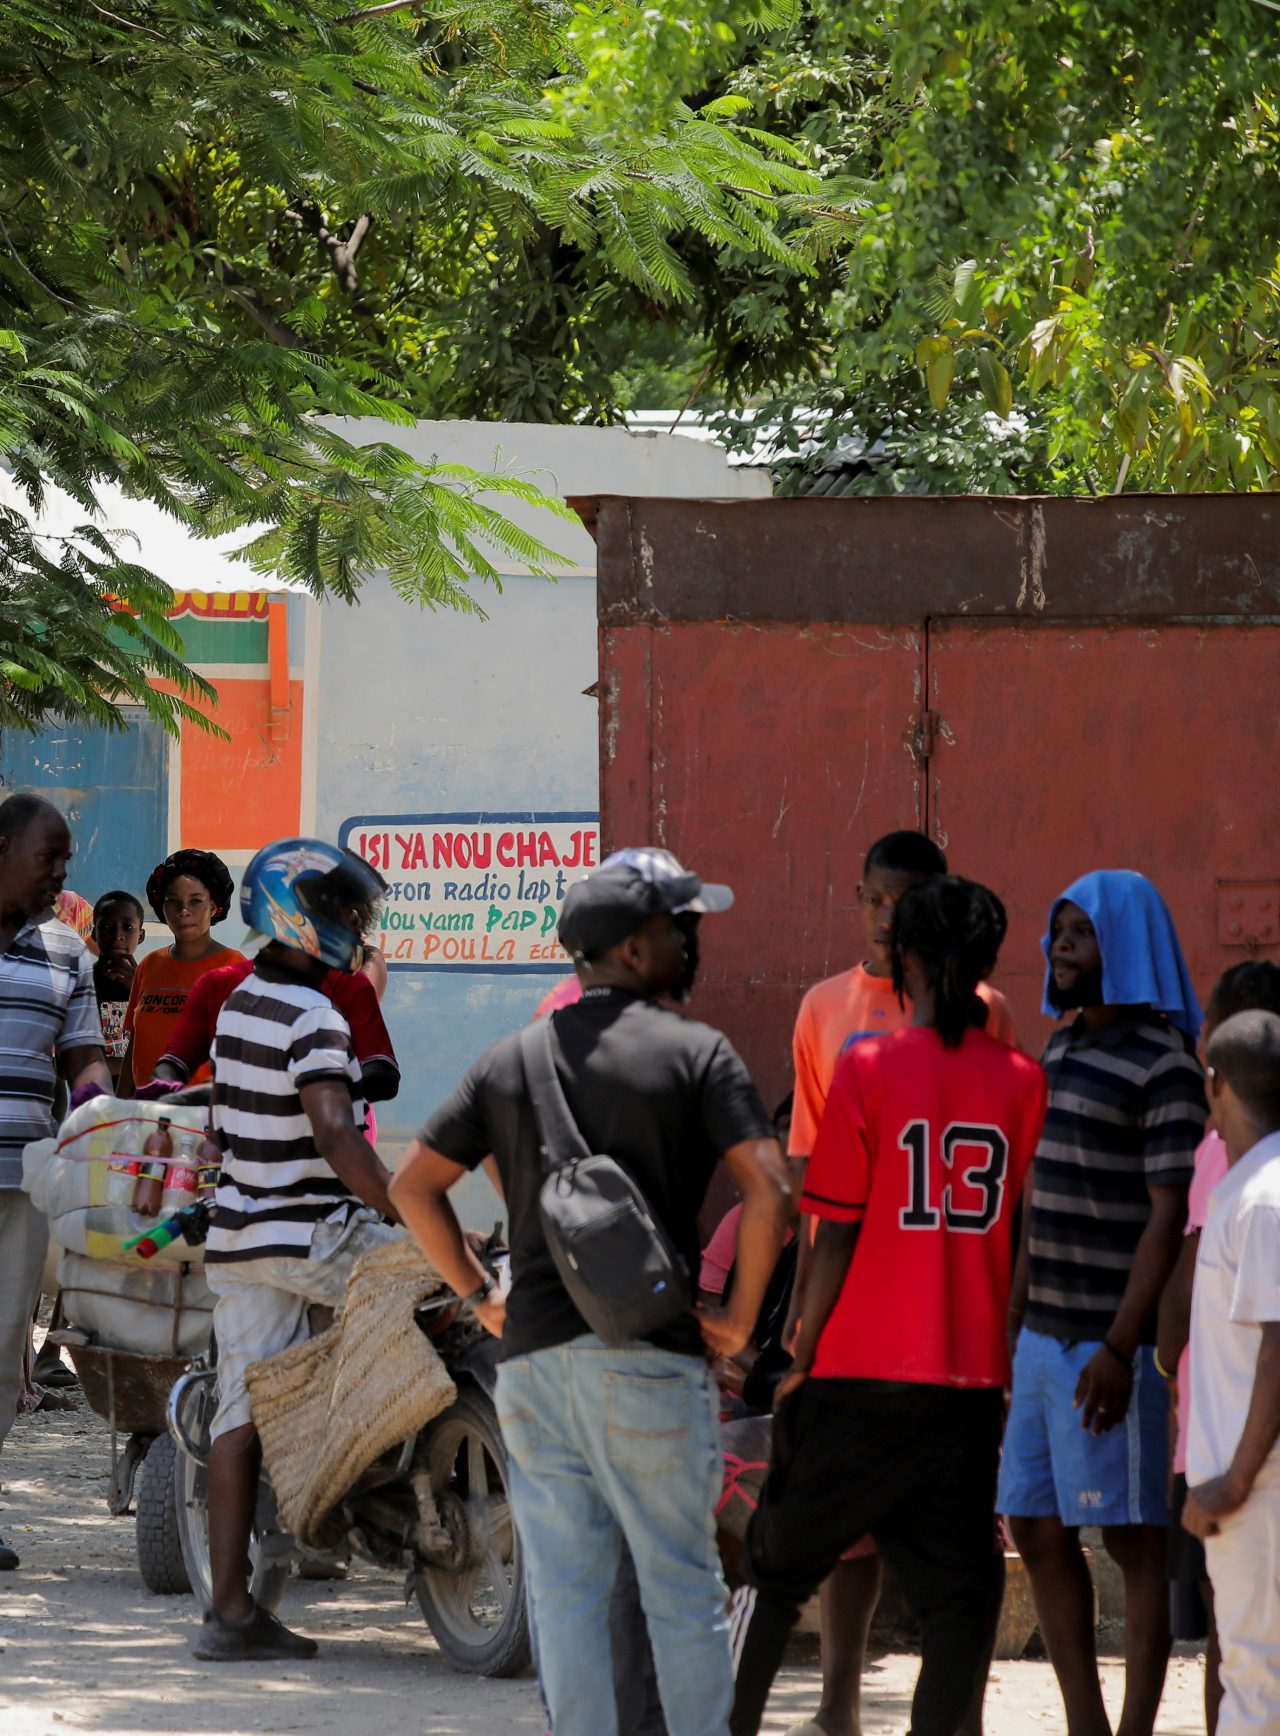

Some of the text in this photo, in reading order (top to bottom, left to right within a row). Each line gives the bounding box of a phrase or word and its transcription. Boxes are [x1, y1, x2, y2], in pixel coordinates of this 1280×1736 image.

[359, 830, 598, 870] ISI YA NOU CHAJE
[443, 872, 512, 902] Radio
[898, 1118, 1009, 1235] 13
